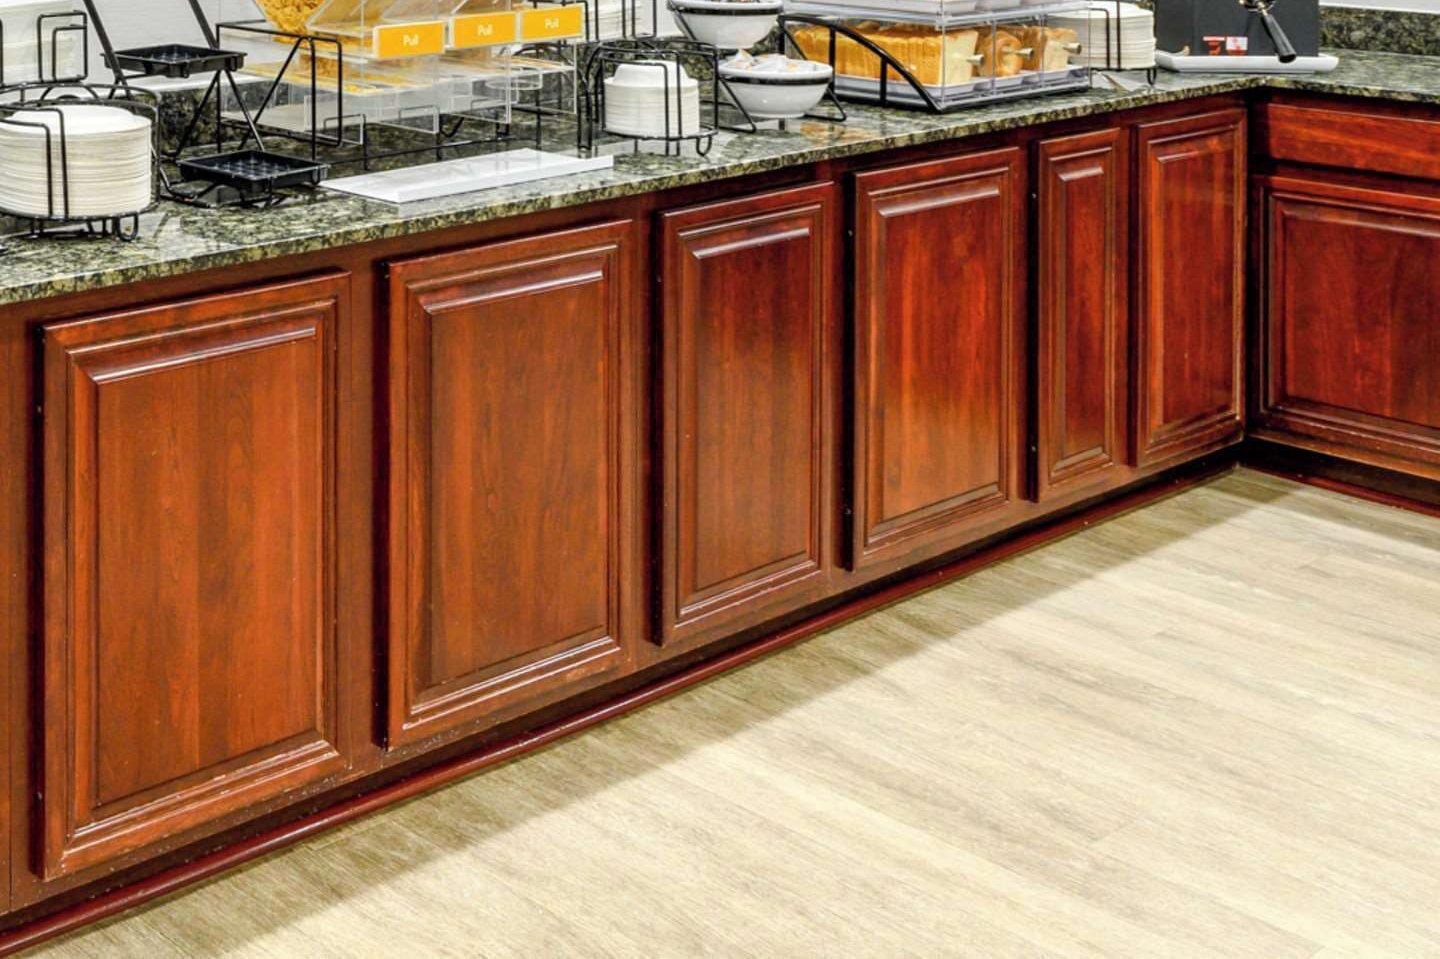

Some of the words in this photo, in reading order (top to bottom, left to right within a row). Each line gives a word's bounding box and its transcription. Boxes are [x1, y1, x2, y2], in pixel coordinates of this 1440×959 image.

[545, 17, 560, 30] Pull
[477, 24, 493, 37] Pull
[402, 34, 419, 47] Pull
